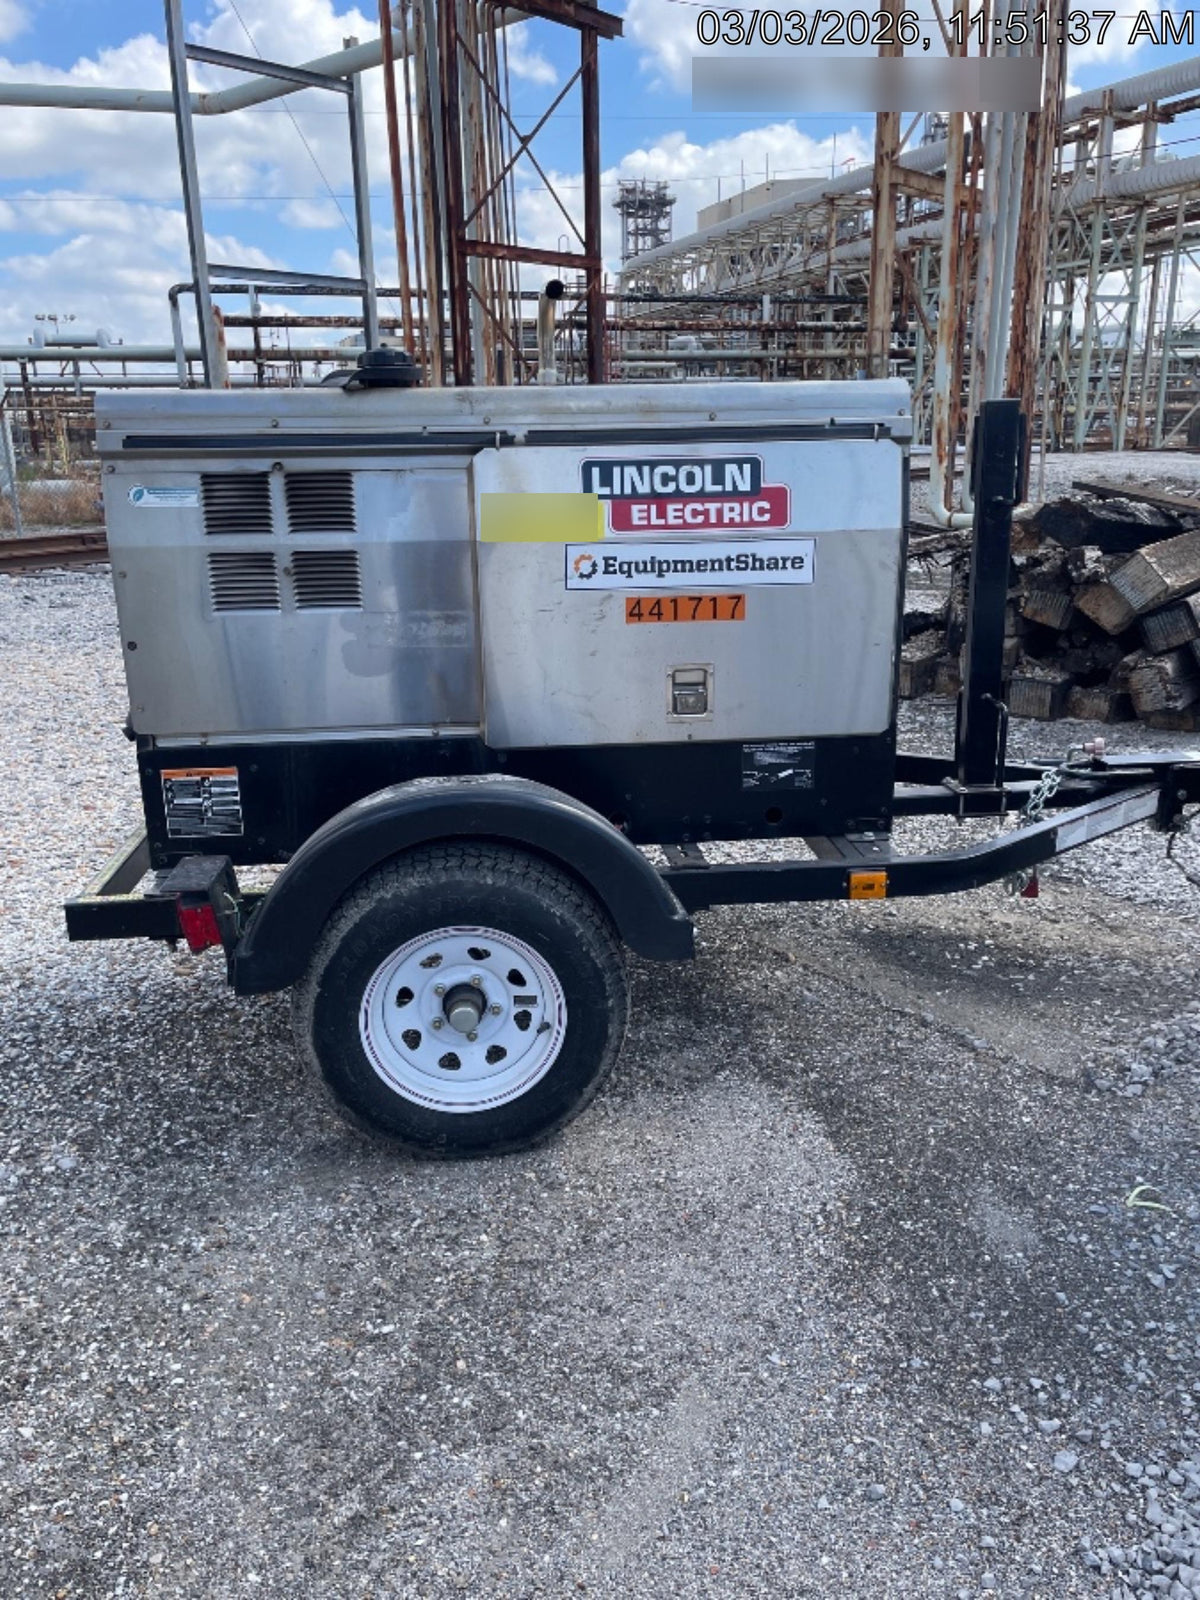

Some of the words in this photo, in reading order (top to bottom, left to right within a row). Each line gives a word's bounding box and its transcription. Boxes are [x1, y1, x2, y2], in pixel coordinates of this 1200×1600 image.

[591, 463, 751, 495] LINCOLN
[630, 501, 771, 525] ELECTRIC
[602, 553, 805, 578] EquipmentShare
[628, 595, 742, 621] 441717
